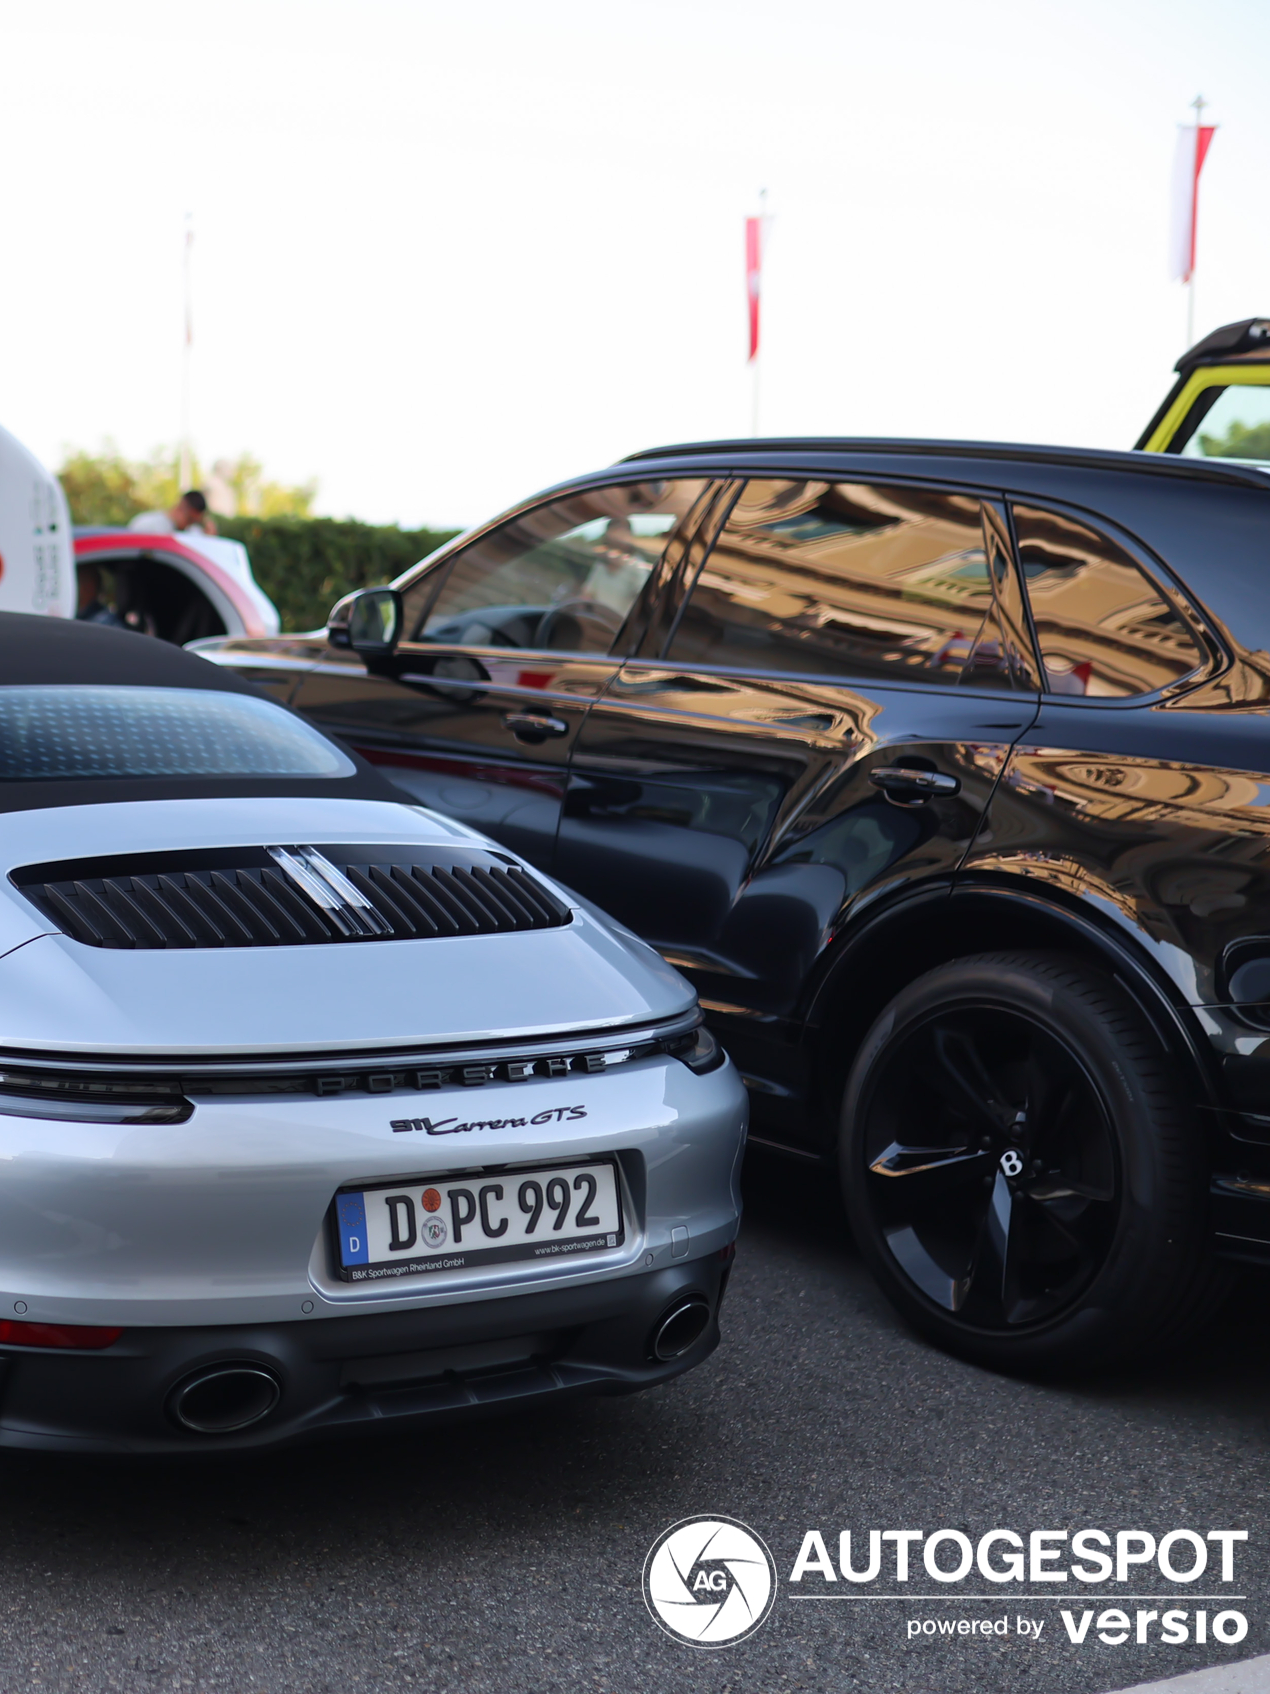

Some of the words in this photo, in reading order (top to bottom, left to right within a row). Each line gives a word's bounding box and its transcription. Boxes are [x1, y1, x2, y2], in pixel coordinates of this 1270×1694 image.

[315, 1053, 606, 1096] PORSCHE
[427, 1117, 528, 1135] Carrera
[530, 1104, 587, 1125] GTS
[385, 1195, 417, 1251] D
[448, 1184, 509, 1243] PC
[518, 1173, 600, 1234] 992
[349, 1236, 360, 1252] D
[534, 1238, 606, 1255] www.bk-sportwagen.de
[352, 1270, 367, 1280] B&K
[368, 1265, 409, 1280] Sportwagen
[410, 1260, 442, 1272] Rheinland
[443, 1258, 465, 1268] GmbH
